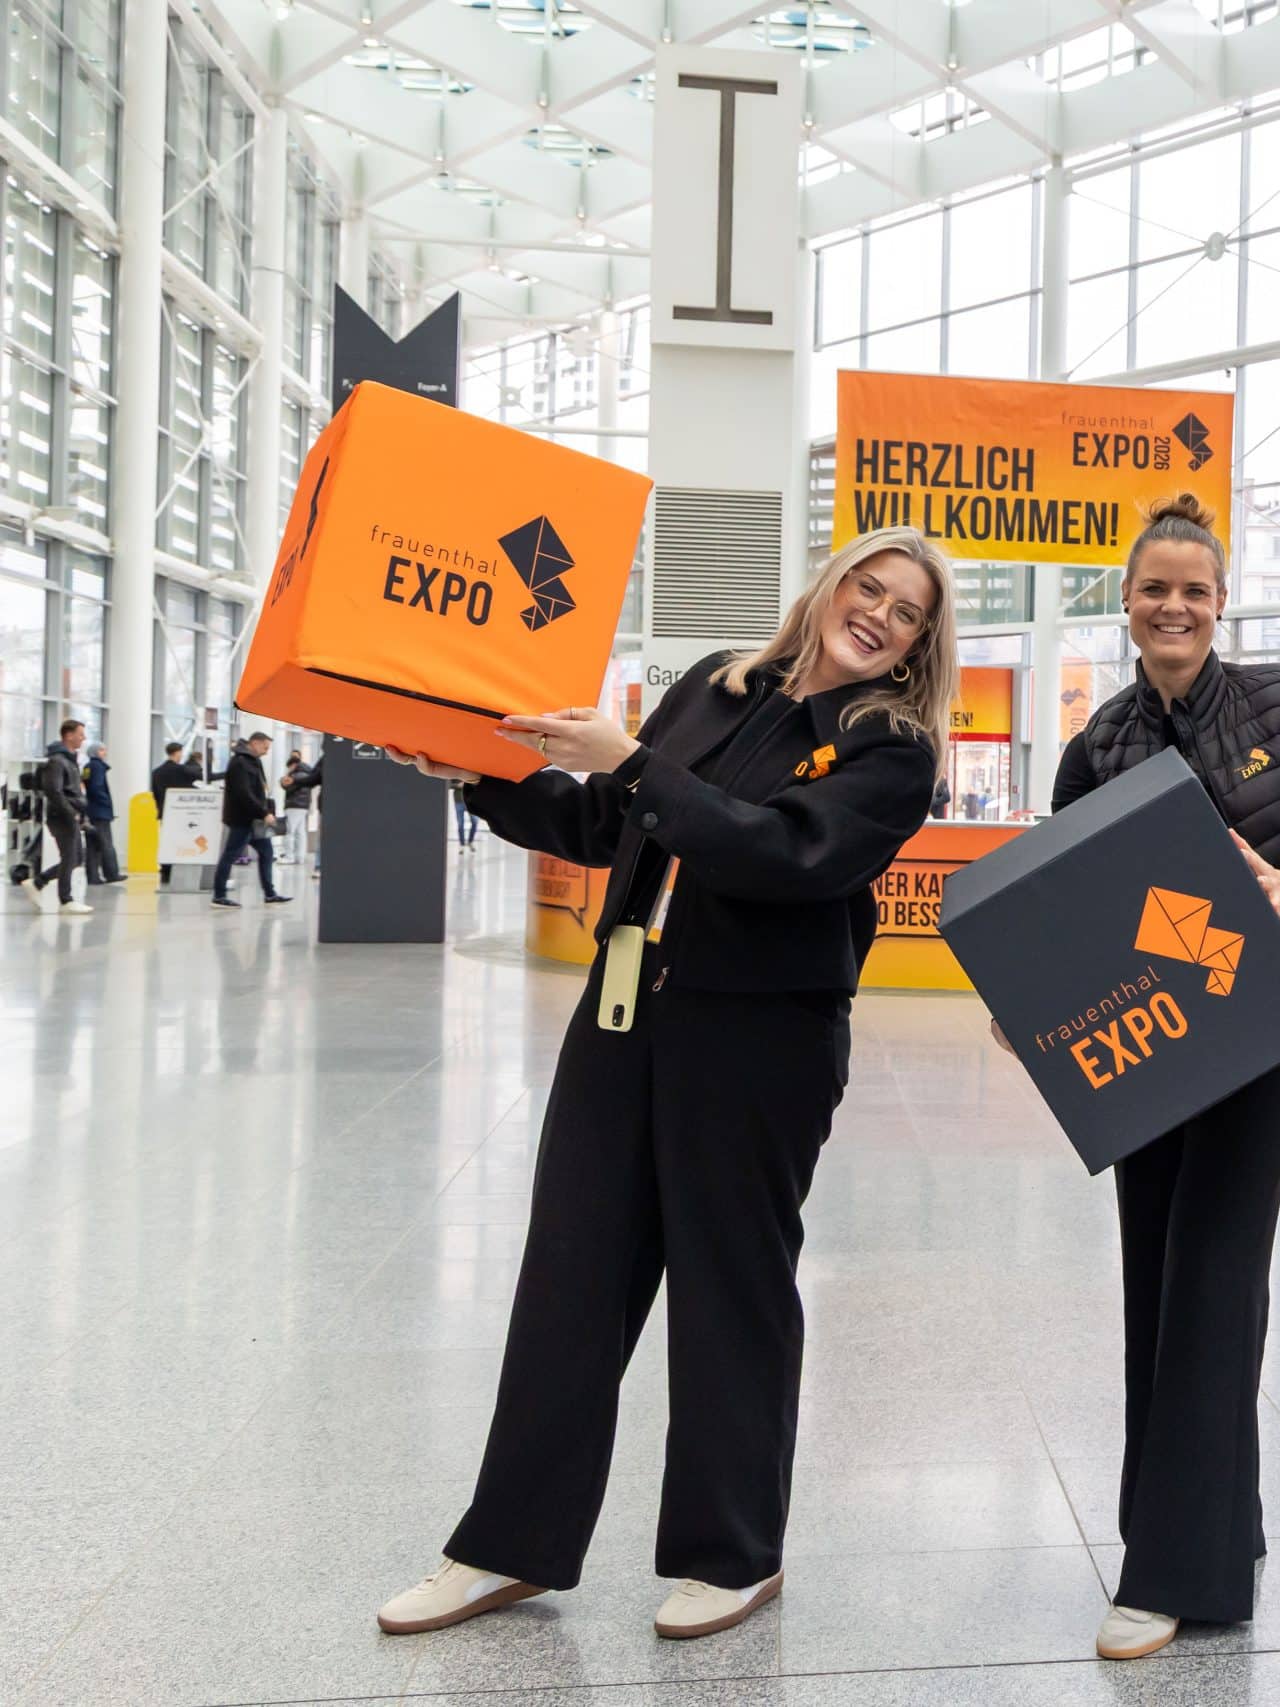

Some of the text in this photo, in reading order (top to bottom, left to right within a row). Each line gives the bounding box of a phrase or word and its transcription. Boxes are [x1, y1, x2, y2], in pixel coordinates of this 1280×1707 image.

[1061, 411, 1154, 430] frauenthal
[856, 438, 1034, 492] HERZLICH
[1073, 432, 1149, 470] EXPO
[1153, 436, 1171, 471] 2026
[854, 489, 1119, 547] WILLKOMMEN!
[370, 524, 498, 577] frauenthal
[383, 555, 493, 626] EXPO
[1241, 761, 1262, 779] EXPO
[1035, 965, 1161, 1053] frauenthal
[1070, 991, 1188, 1090] EXPO
